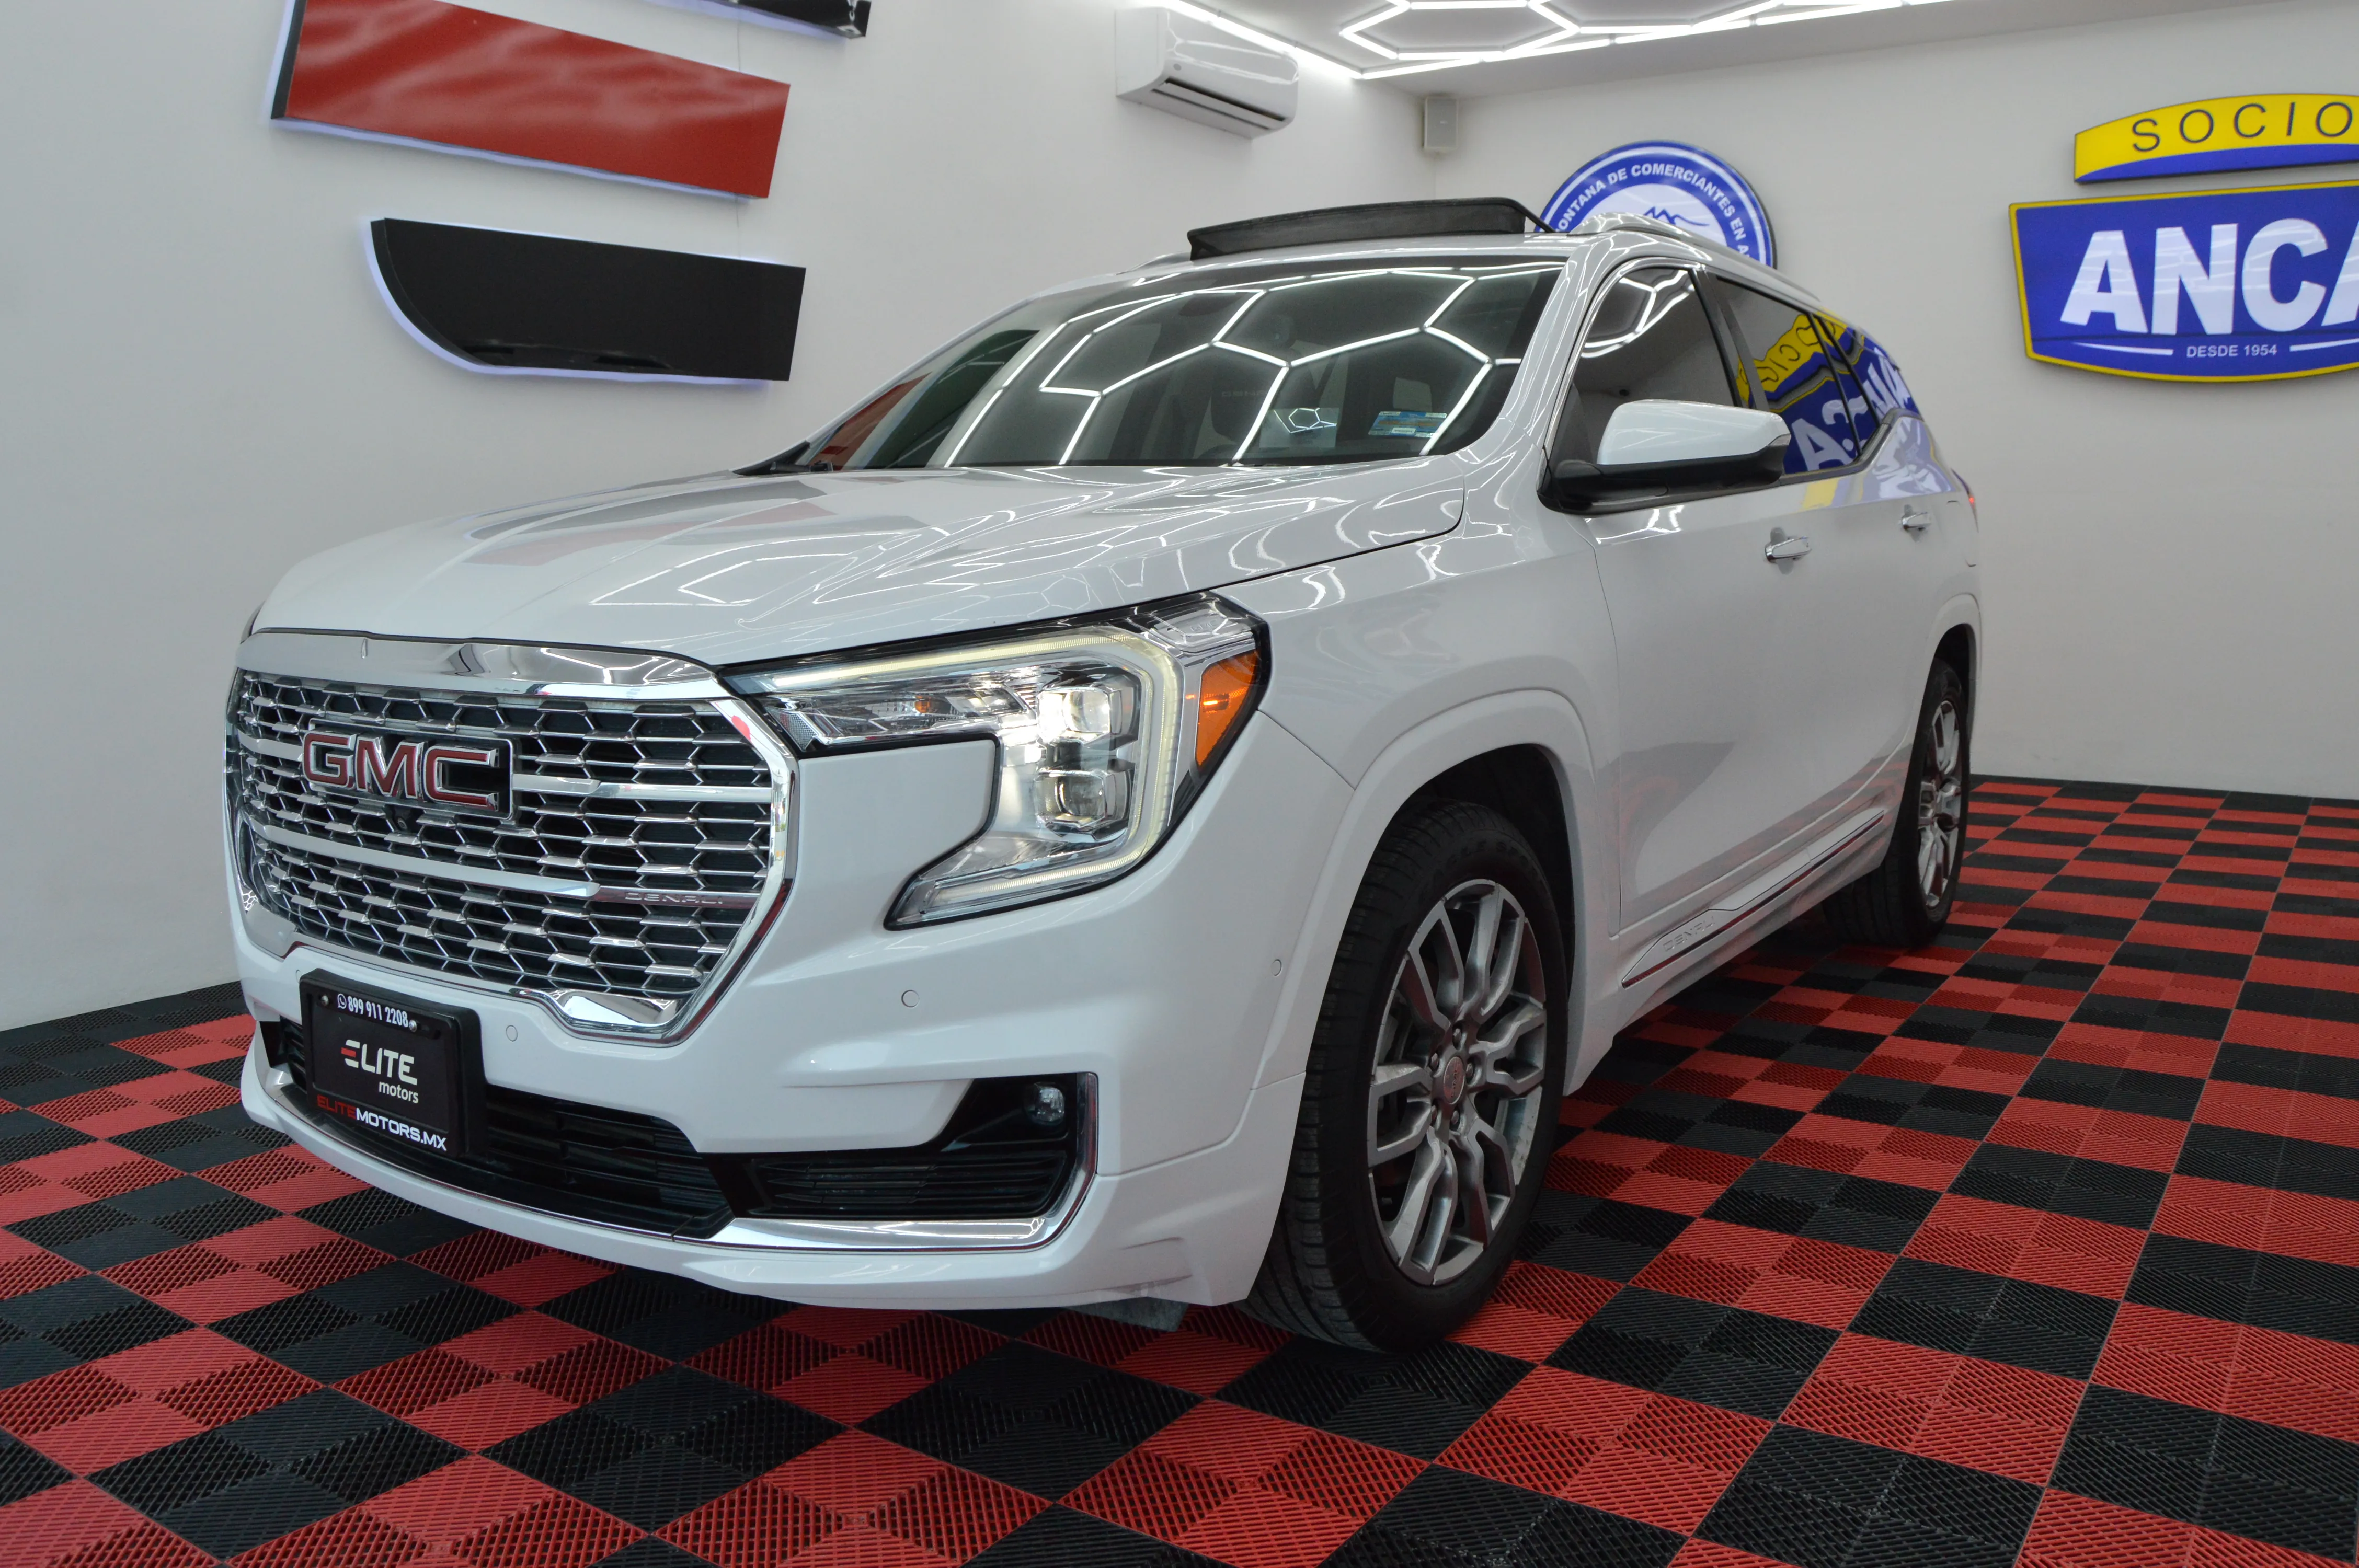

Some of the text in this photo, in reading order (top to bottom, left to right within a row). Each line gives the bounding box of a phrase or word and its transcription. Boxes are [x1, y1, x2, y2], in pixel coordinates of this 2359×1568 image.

[2131, 101, 2353, 152] SOCIO
[1555, 180, 1607, 232] ONTANA
[1607, 167, 1628, 185] DE
[1630, 163, 1736, 217] COMERCIANTES
[1729, 217, 1747, 241] EN
[2186, 344, 2277, 358] DESDE 1954
[302, 732, 499, 811] GMC
[625, 891, 724, 904] DENALI
[347, 995, 409, 1028] 899 911 2208
[340, 1039, 417, 1086] ELITE
[378, 1081, 419, 1104] motors
[317, 1094, 447, 1151] ELITEMOTORS.MX
